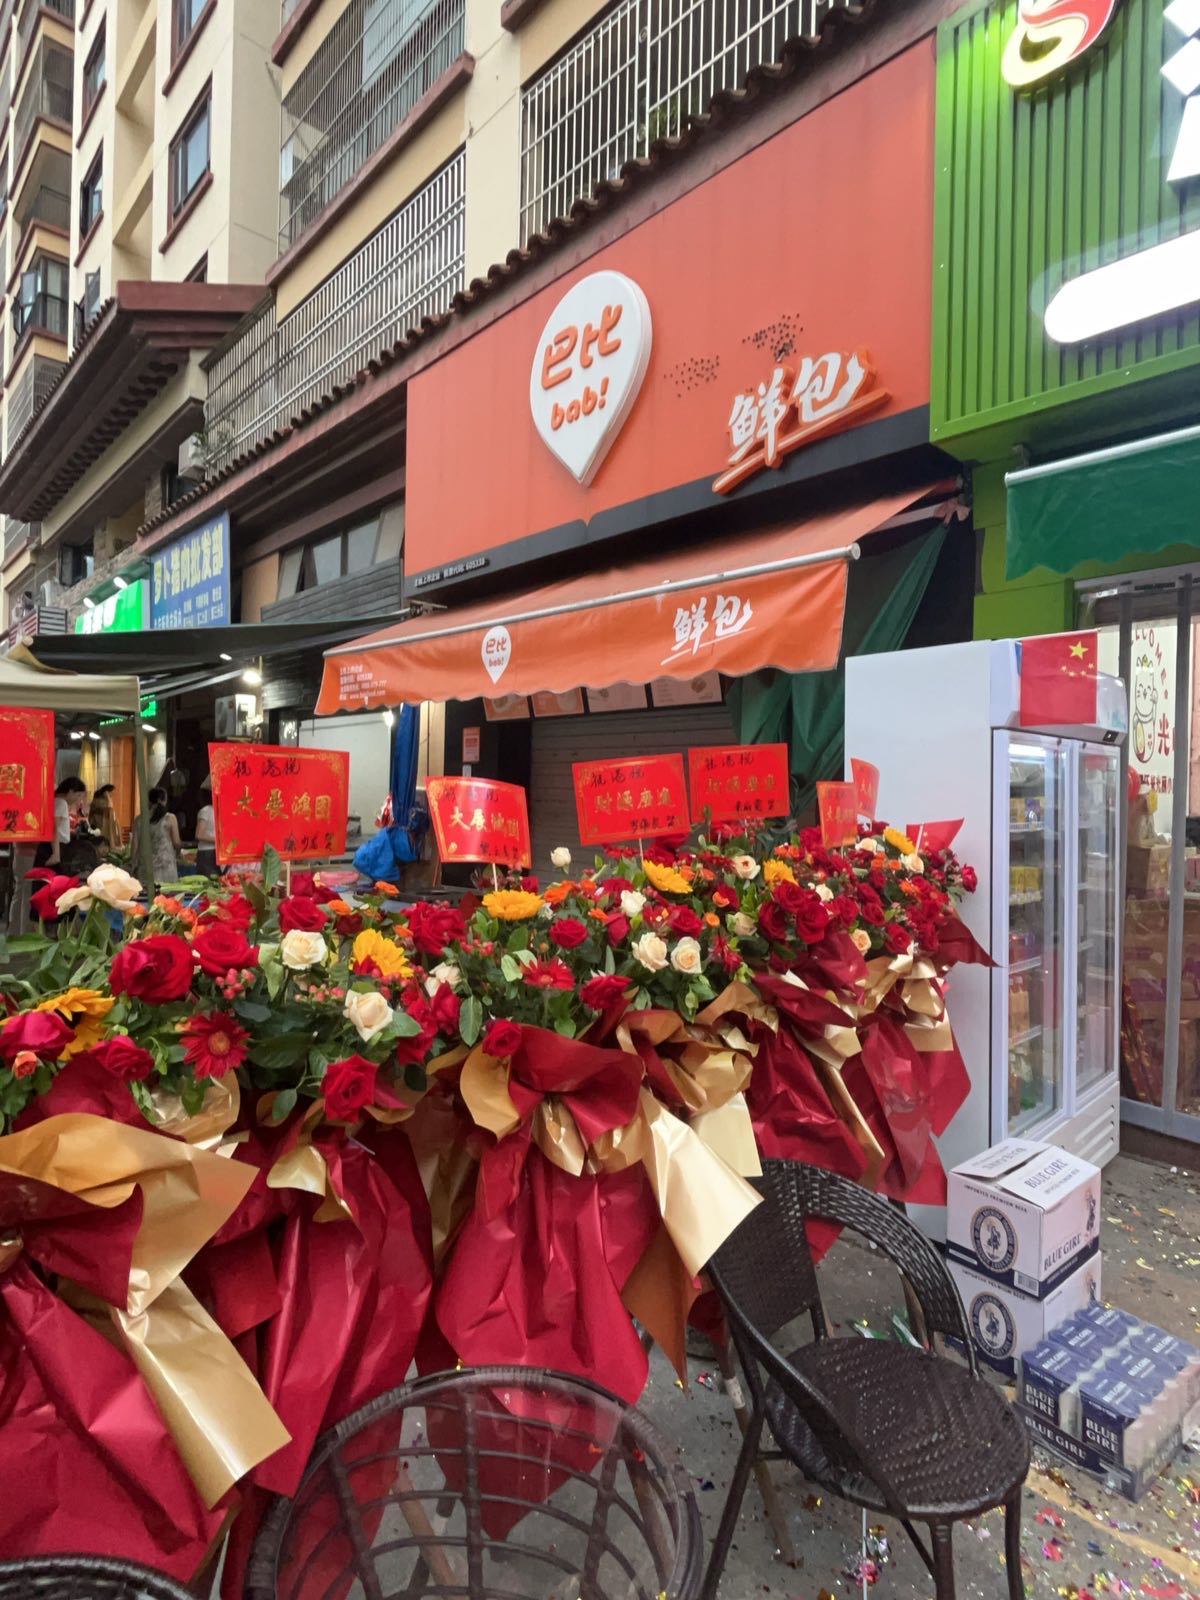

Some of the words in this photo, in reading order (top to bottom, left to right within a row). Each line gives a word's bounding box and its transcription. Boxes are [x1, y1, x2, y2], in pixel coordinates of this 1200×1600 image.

[541, 303, 623, 391] 巴比
[727, 351, 868, 464] 鲜包
[671, 594, 753, 656] 鲜包
[1043, 1247, 1063, 1272] BLUE
[1063, 1233, 1081, 1255] GIRL
[1025, 1384, 1055, 1408] BLUE
[1025, 1394, 1056, 1418] GIRL
[1024, 1415, 1055, 1441] BLUE
[1055, 1435, 1086, 1460] GIRL
[1086, 1417, 1119, 1445] BLUE
[1086, 1429, 1119, 1453] GIRL
